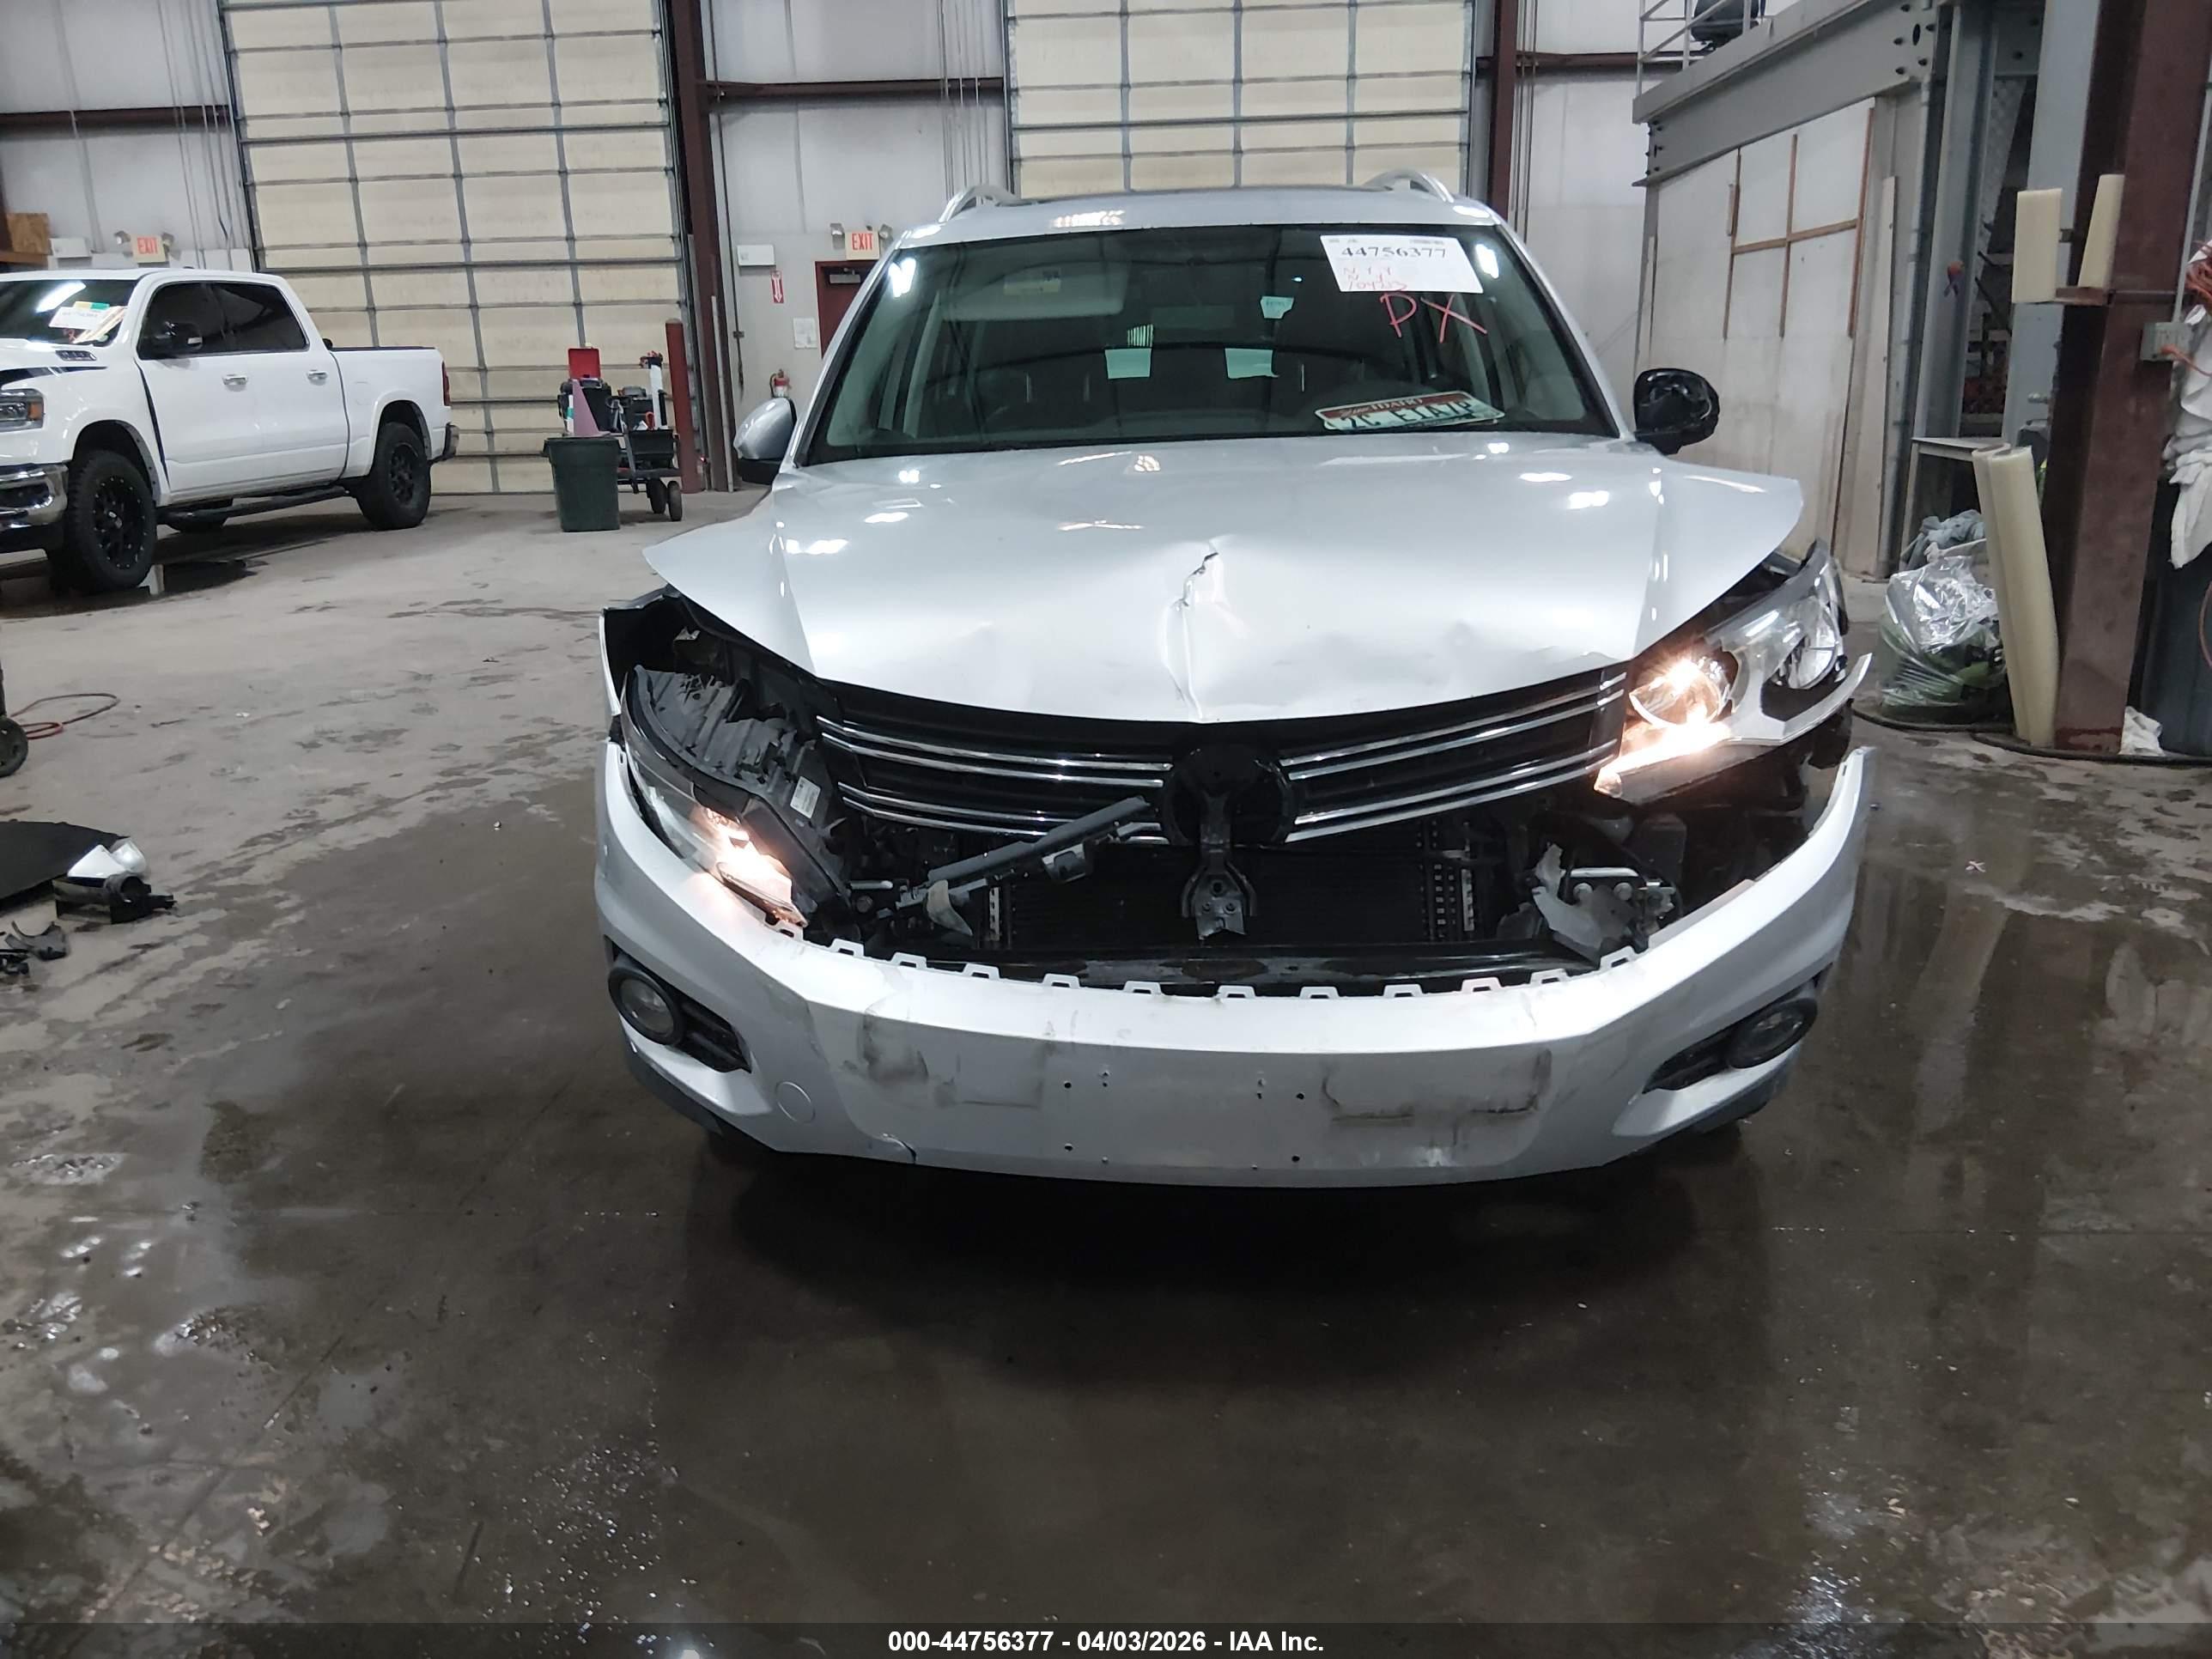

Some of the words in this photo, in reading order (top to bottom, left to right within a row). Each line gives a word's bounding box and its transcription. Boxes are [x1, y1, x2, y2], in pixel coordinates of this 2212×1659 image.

[137, 236, 159, 255] EXIT
[851, 232, 873, 251] EXIT
[1341, 246, 1447, 258] 44756377
